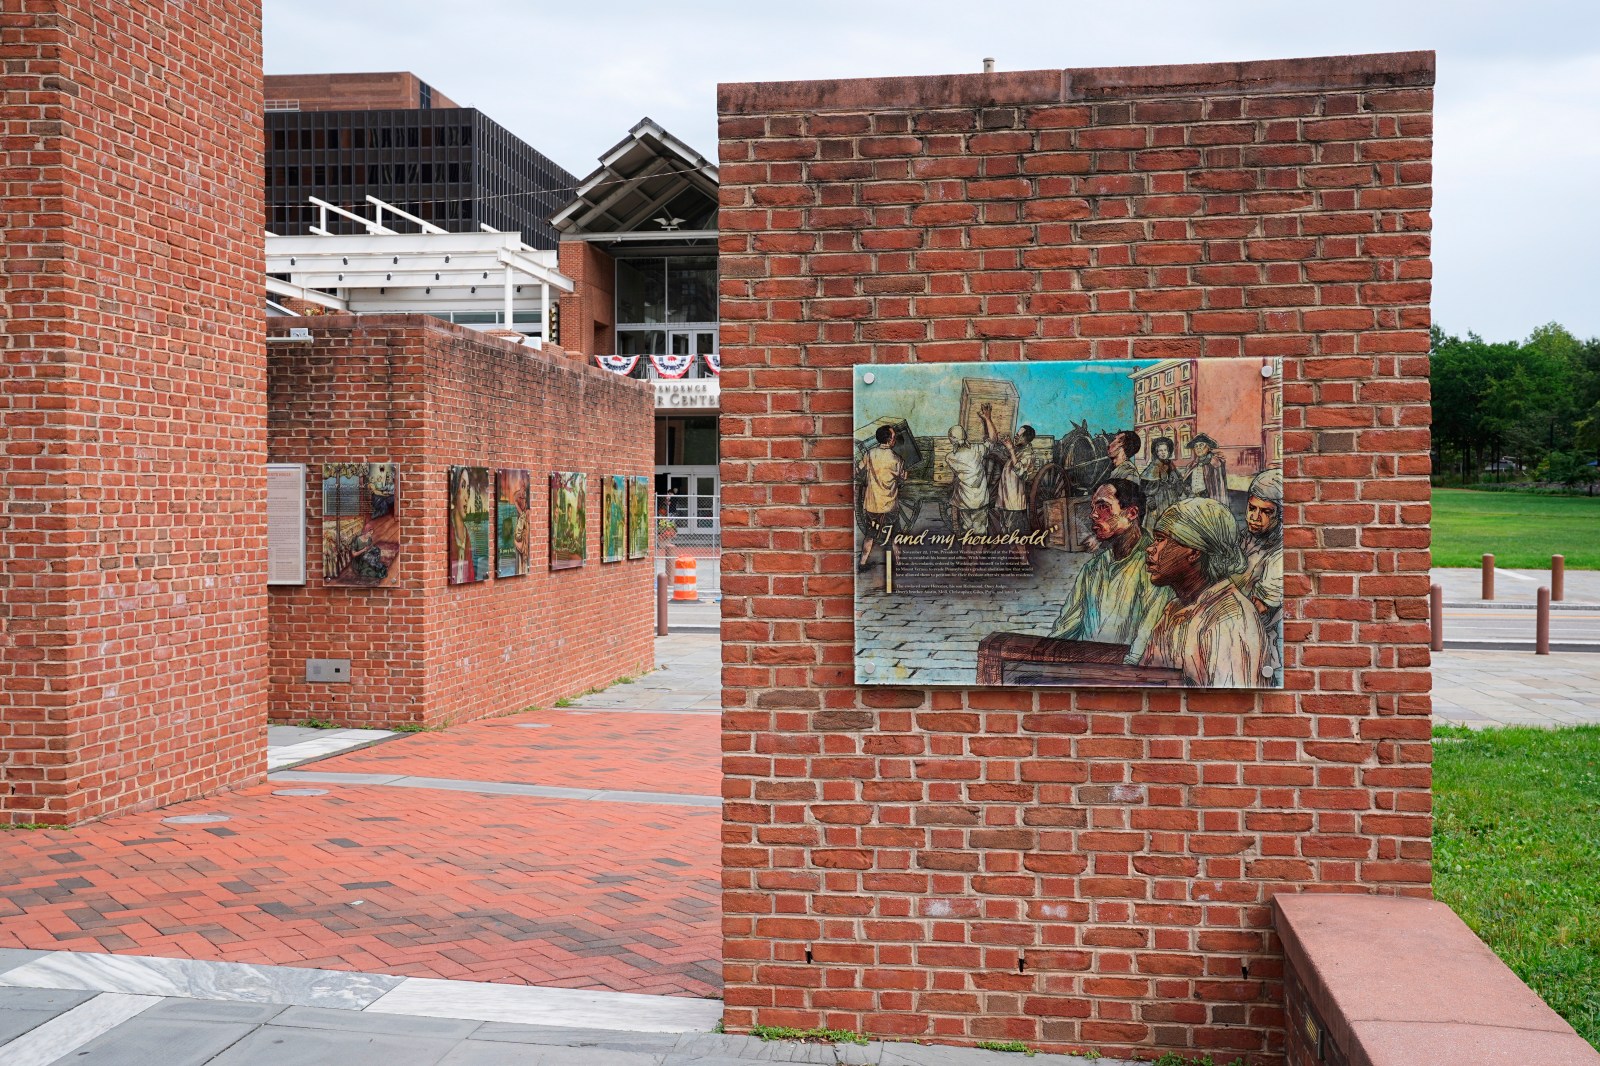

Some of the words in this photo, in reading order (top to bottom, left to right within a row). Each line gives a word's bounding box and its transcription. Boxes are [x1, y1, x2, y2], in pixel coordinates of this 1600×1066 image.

[894, 529, 929, 546] and
[928, 534, 956, 551] my
[958, 524, 1059, 548] household"
